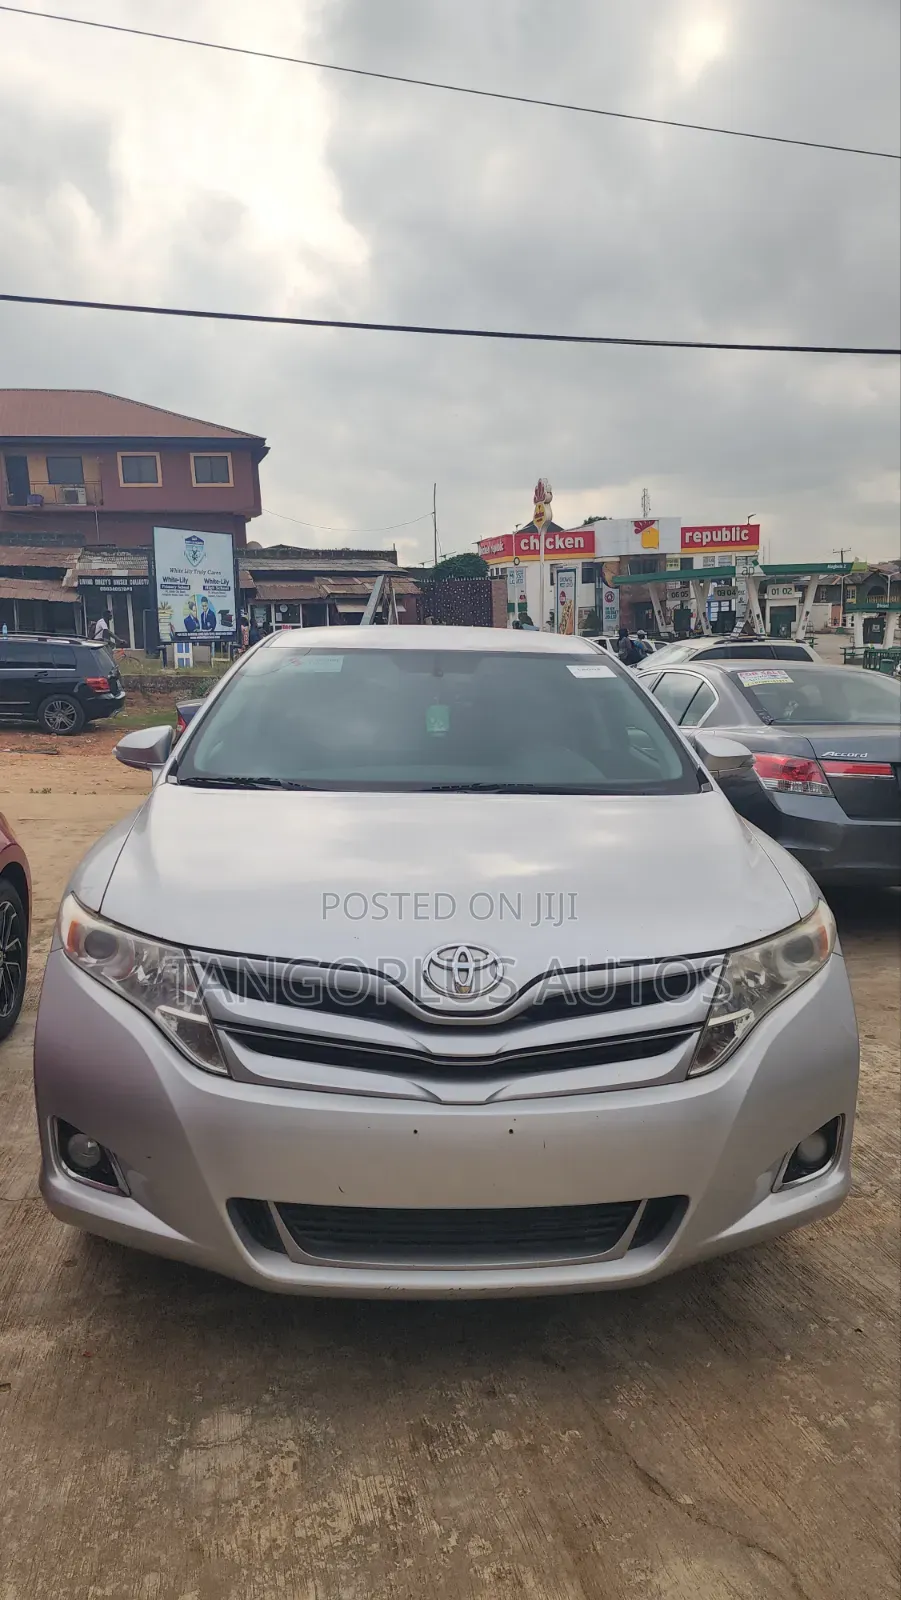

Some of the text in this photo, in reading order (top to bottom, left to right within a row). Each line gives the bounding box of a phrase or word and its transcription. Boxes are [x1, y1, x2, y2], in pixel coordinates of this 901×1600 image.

[685, 526, 749, 546] republic
[520, 534, 584, 551] chcken
[162, 576, 189, 584] White-Lily
[203, 578, 230, 586] White-Lily
[681, 590, 689, 598] 05
[727, 588, 736, 596] 04
[771, 588, 780, 596] 01
